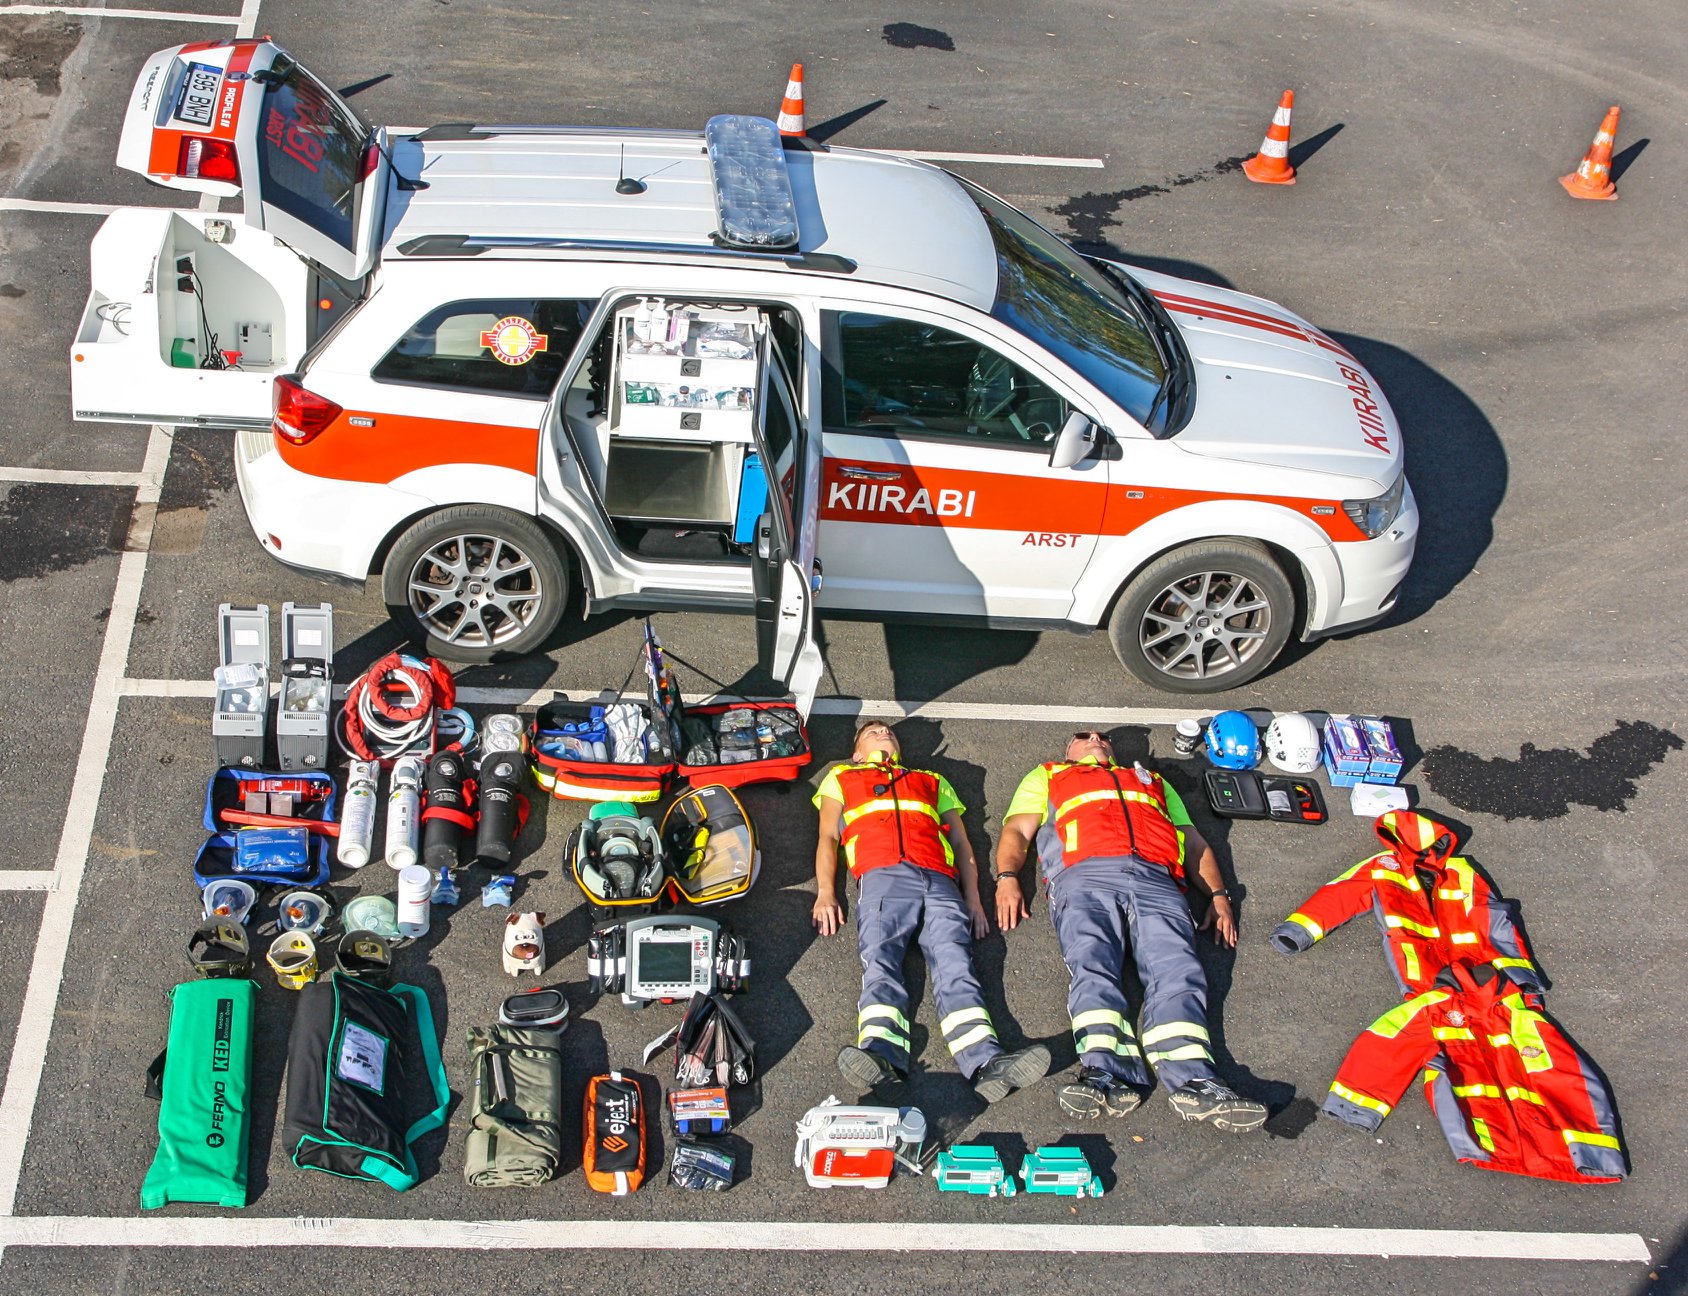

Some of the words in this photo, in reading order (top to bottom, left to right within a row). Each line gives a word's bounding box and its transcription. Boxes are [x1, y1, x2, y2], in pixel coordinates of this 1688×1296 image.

[193, 73, 216, 93] 595
[185, 95, 211, 120] BNH
[222, 87, 236, 119] PROFILE
[265, 107, 286, 148] ARST
[1335, 360, 1391, 455] KIIRABI
[827, 482, 976, 517] KIIRABI
[1021, 532, 1082, 548] ARST
[213, 1039, 229, 1069] KED
[211, 1081, 226, 1131] FERNO
[605, 1098, 630, 1135] eject
